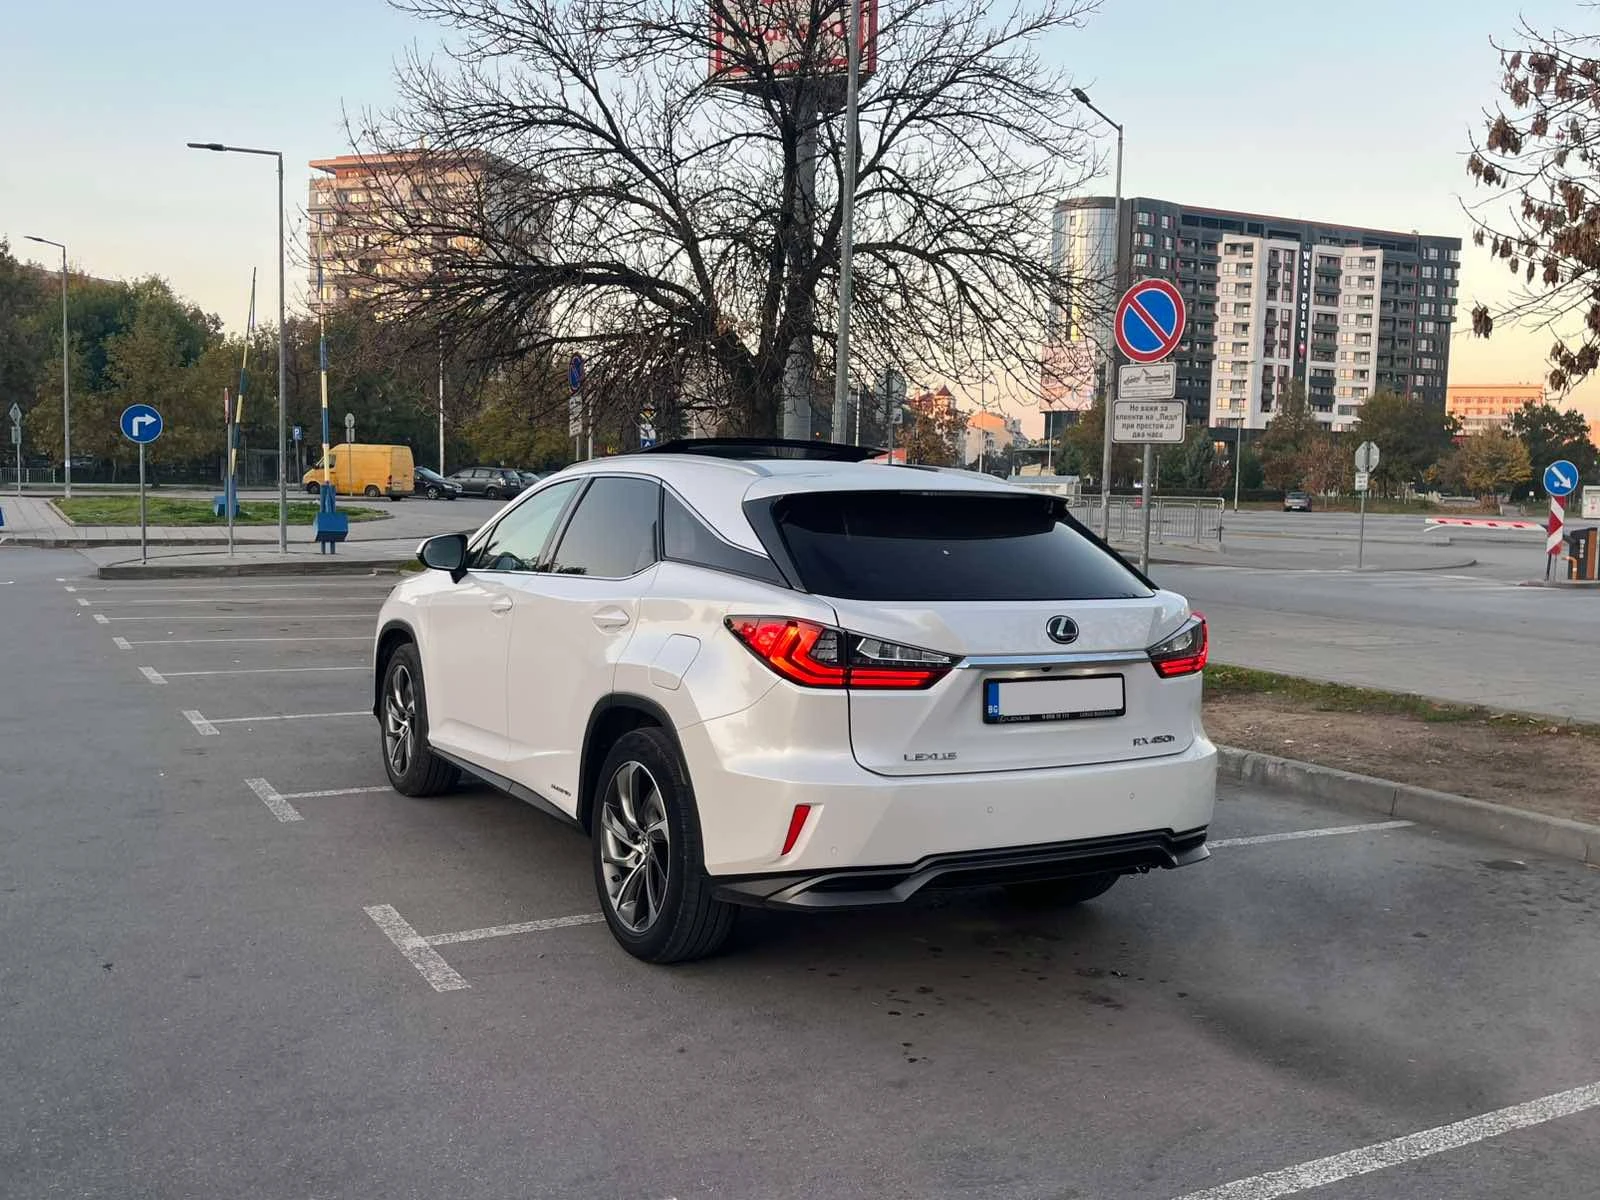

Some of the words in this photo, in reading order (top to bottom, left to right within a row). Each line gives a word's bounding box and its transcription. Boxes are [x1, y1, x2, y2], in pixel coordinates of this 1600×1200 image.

[1302, 251, 1311, 287] West
[1300, 293, 1308, 339] Point
[987, 705, 998, 714] BG
[1133, 737, 1149, 746] RX
[904, 751, 958, 761] LEXUS
